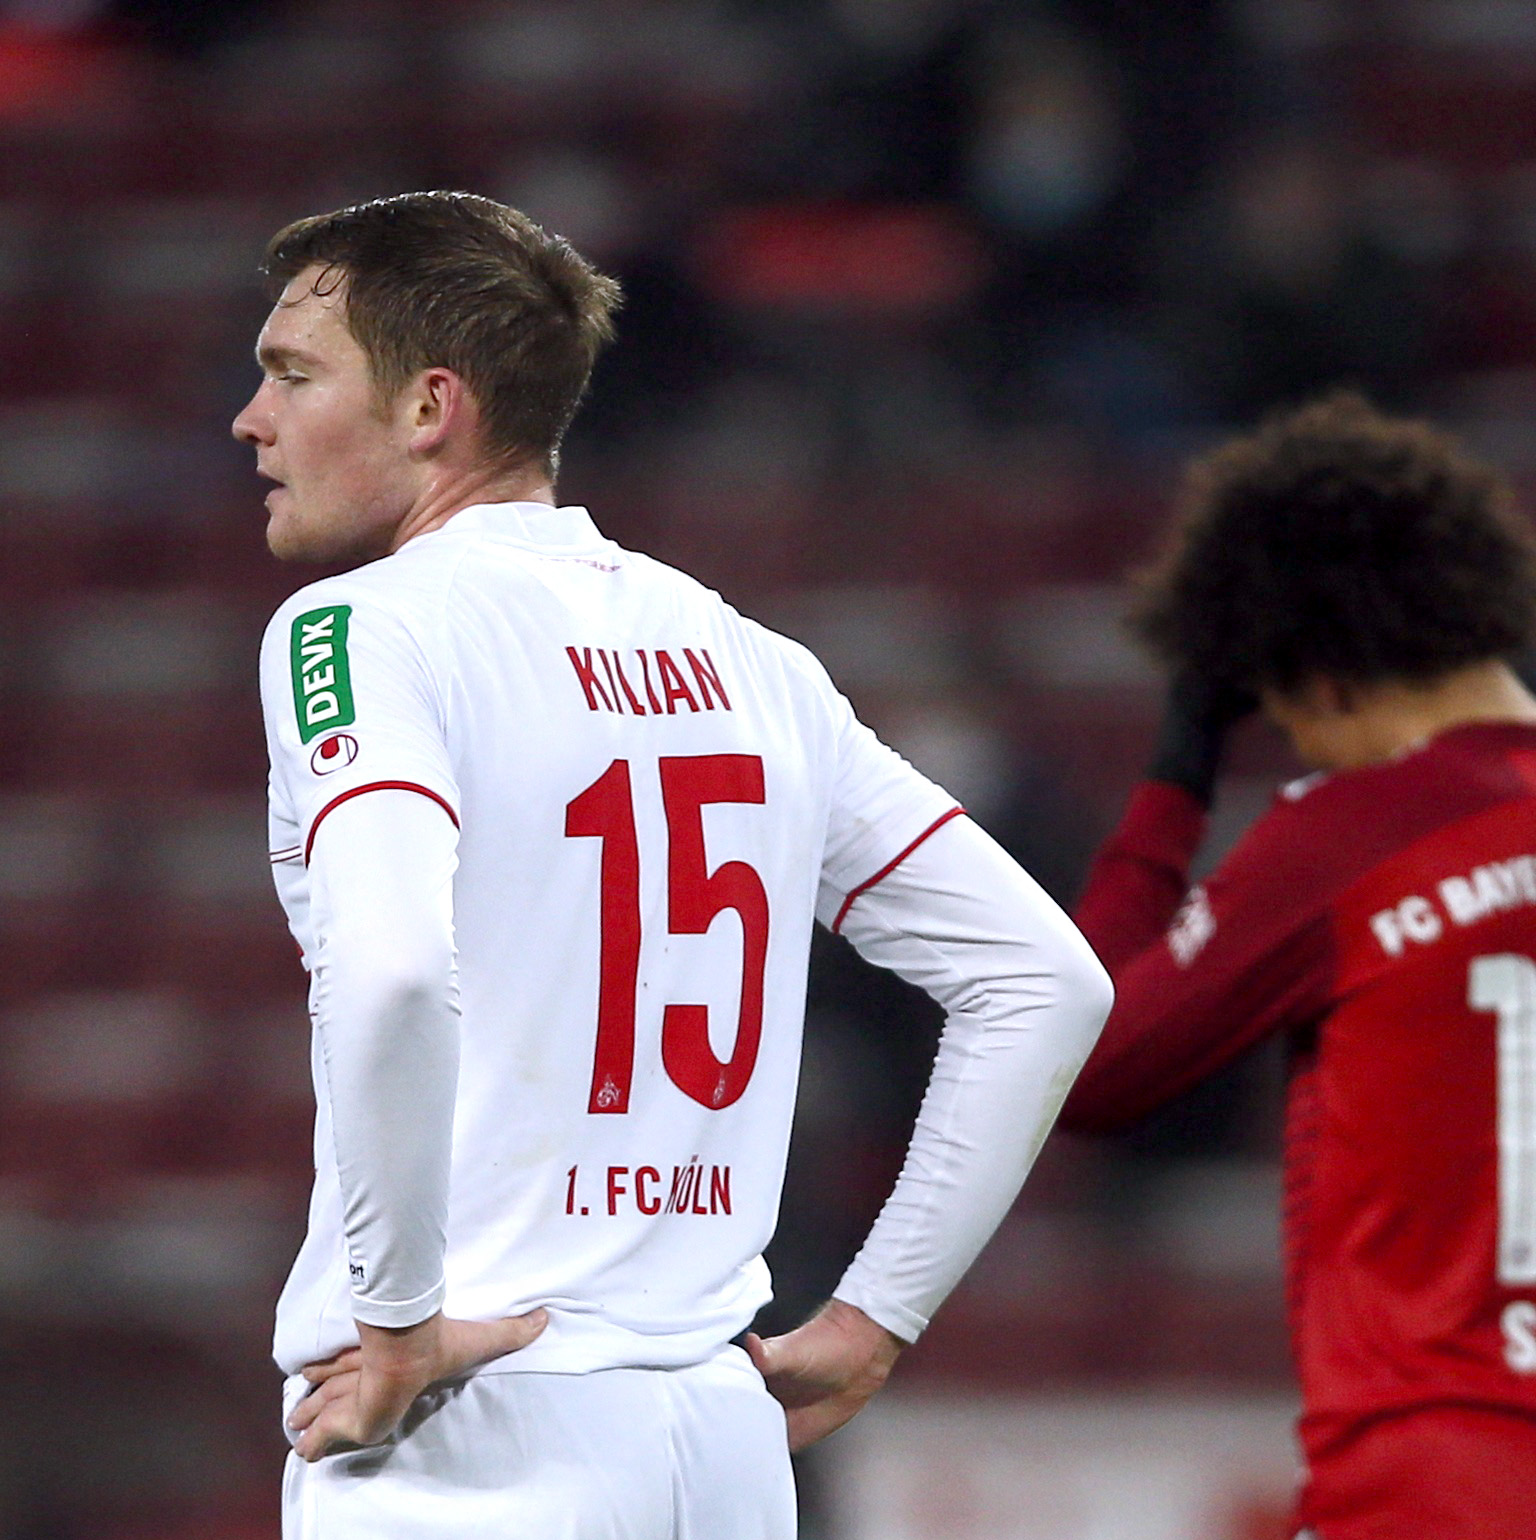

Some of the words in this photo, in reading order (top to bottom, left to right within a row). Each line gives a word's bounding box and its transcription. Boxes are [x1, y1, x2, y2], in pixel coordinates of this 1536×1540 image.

[301, 613, 340, 726] DEVK
[565, 646, 732, 716] KILIAN
[564, 754, 769, 1114] 15
[1369, 896, 1443, 956] FC
[566, 1164, 589, 1216] 1.
[607, 1165, 661, 1216] FC
[665, 1154, 732, 1216] KÖLN
